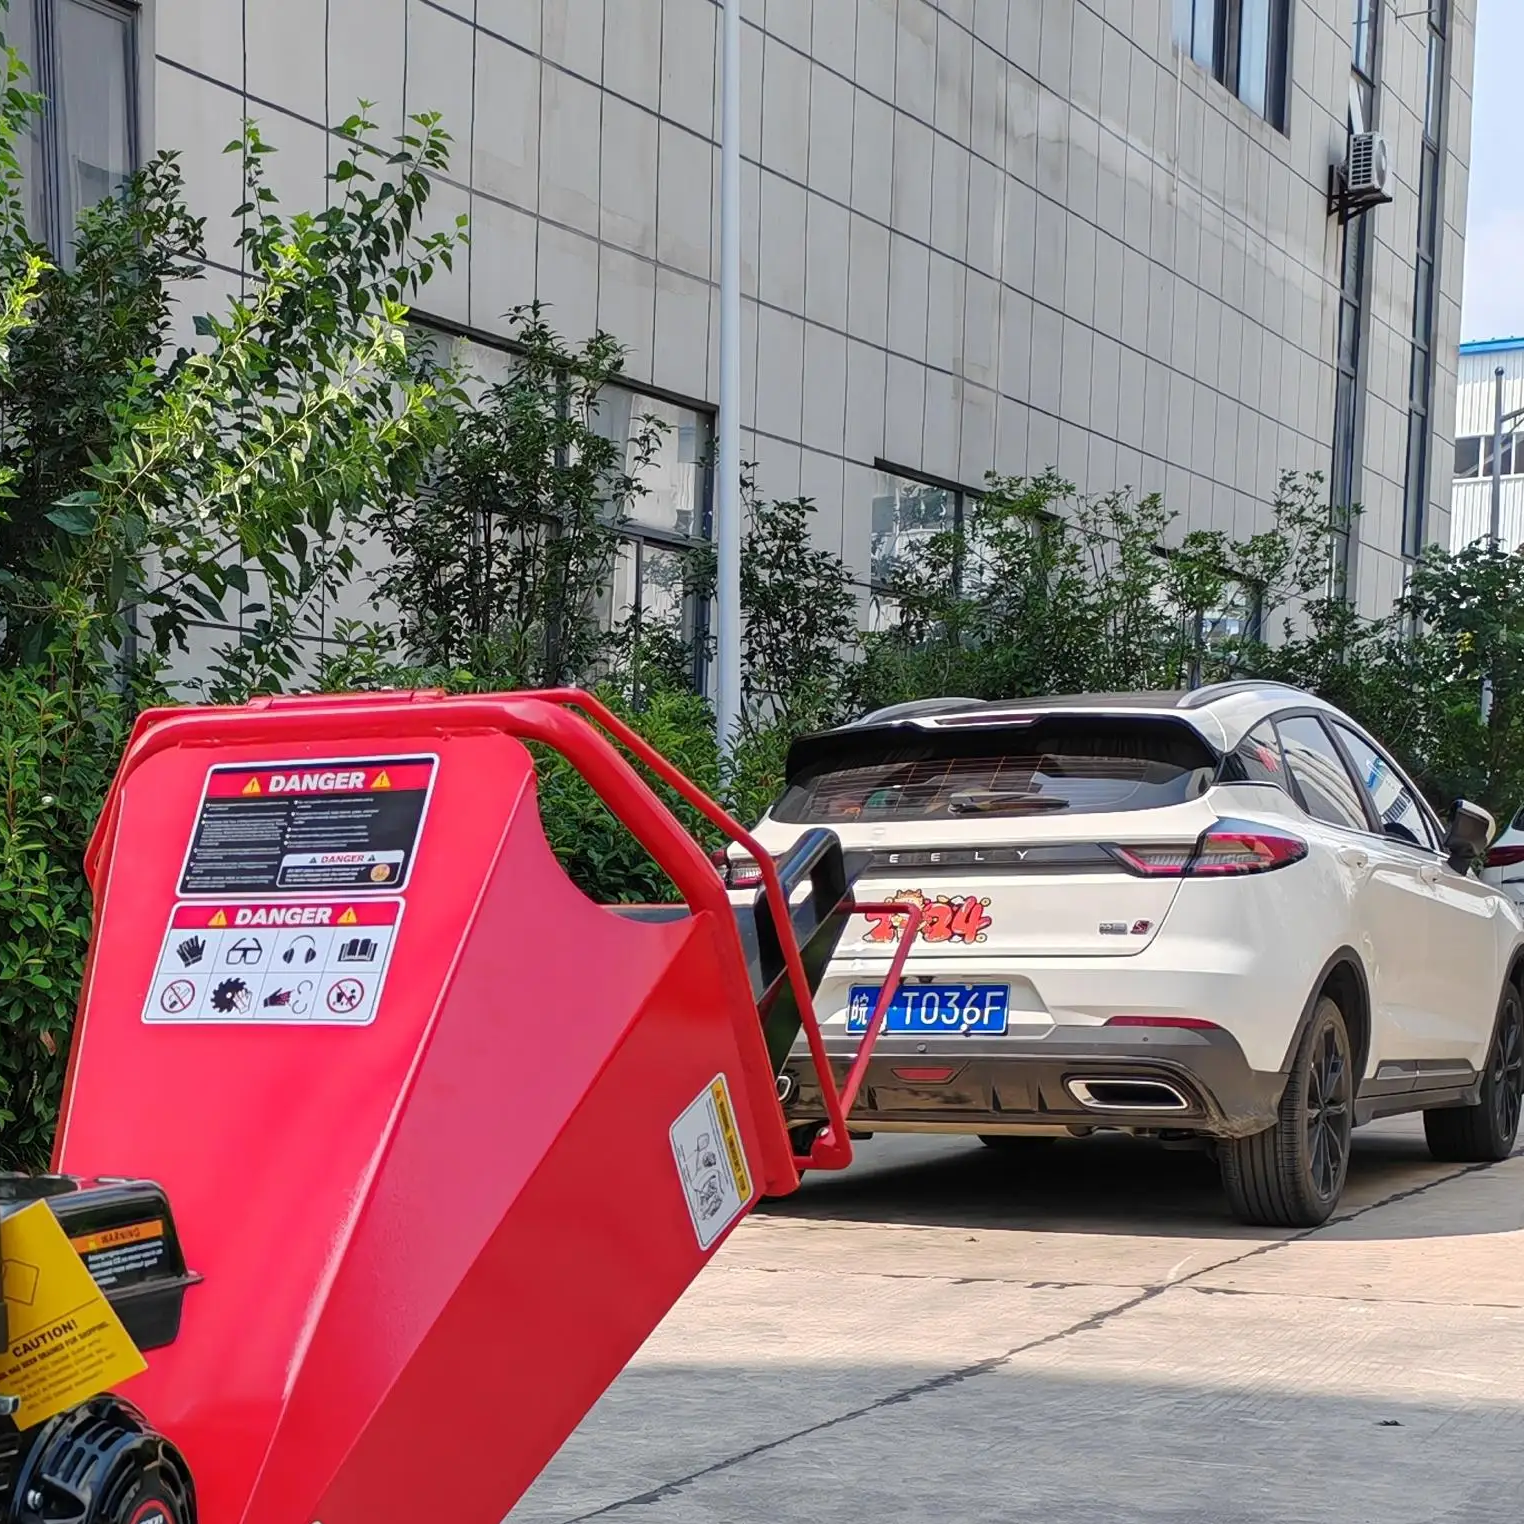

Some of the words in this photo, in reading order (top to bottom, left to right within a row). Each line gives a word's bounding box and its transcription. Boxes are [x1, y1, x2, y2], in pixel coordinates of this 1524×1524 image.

[269, 772, 366, 792] DANGER
[321, 855, 364, 863] DANGER
[889, 850, 1028, 863] EELY
[234, 907, 332, 925] DANGER
[12, 1319, 78, 1357] CAUTION!
